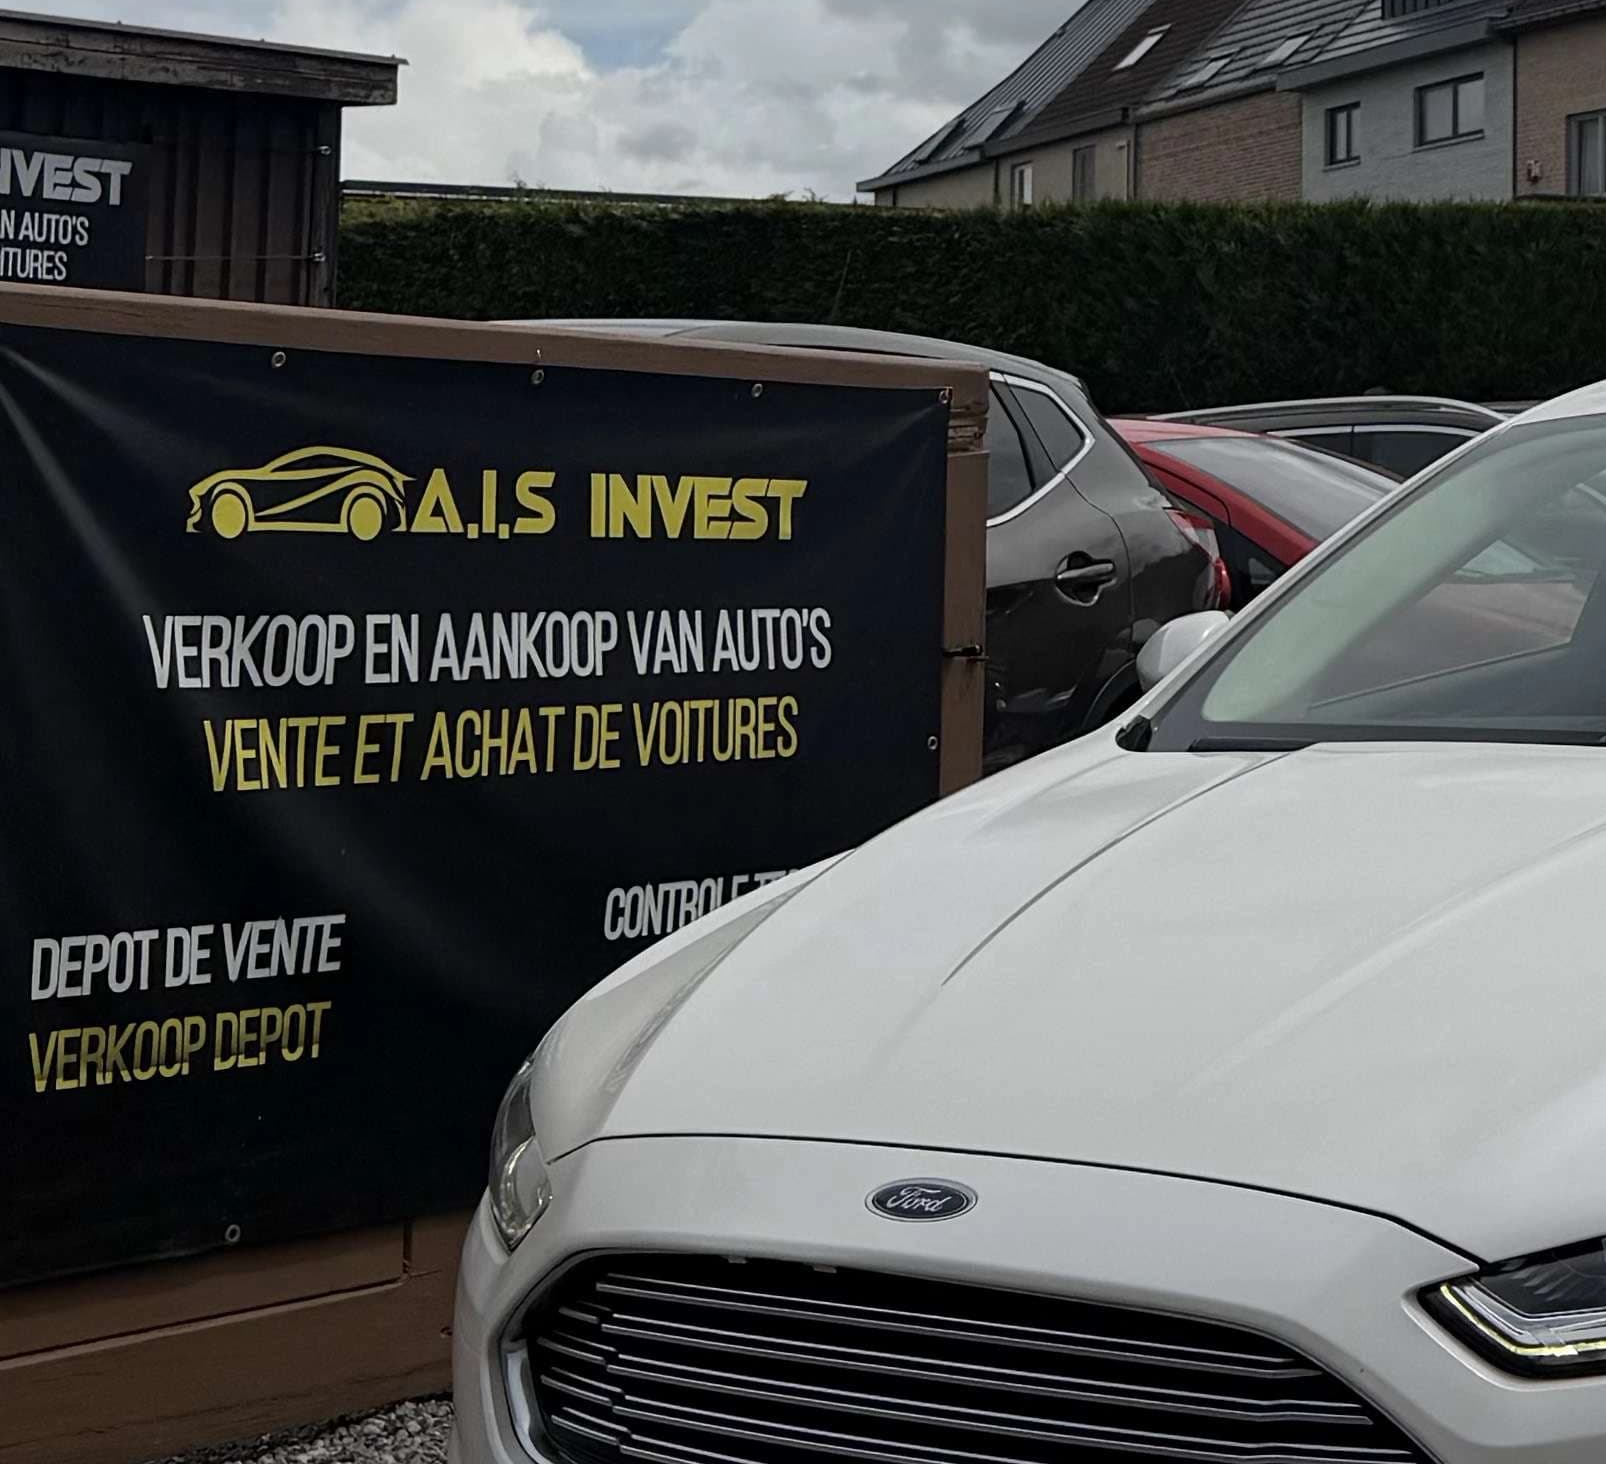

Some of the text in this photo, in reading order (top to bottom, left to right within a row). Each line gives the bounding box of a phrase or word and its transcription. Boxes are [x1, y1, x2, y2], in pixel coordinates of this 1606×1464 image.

[0, 247, 68, 281] ITURES
[18, 211, 89, 246] AUTO'S
[410, 468, 807, 540] A.I.S INVEST
[142, 607, 832, 689] VERKOOP EN AANKOOP VAN AUTO'S
[203, 695, 798, 792] VENTE ET ACHAT DE VOITURES
[30, 914, 347, 1001] DEPOT DE VENTE
[28, 1001, 332, 1093] VERKOOP DEPOT
[886, 1186, 952, 1212] Ford
